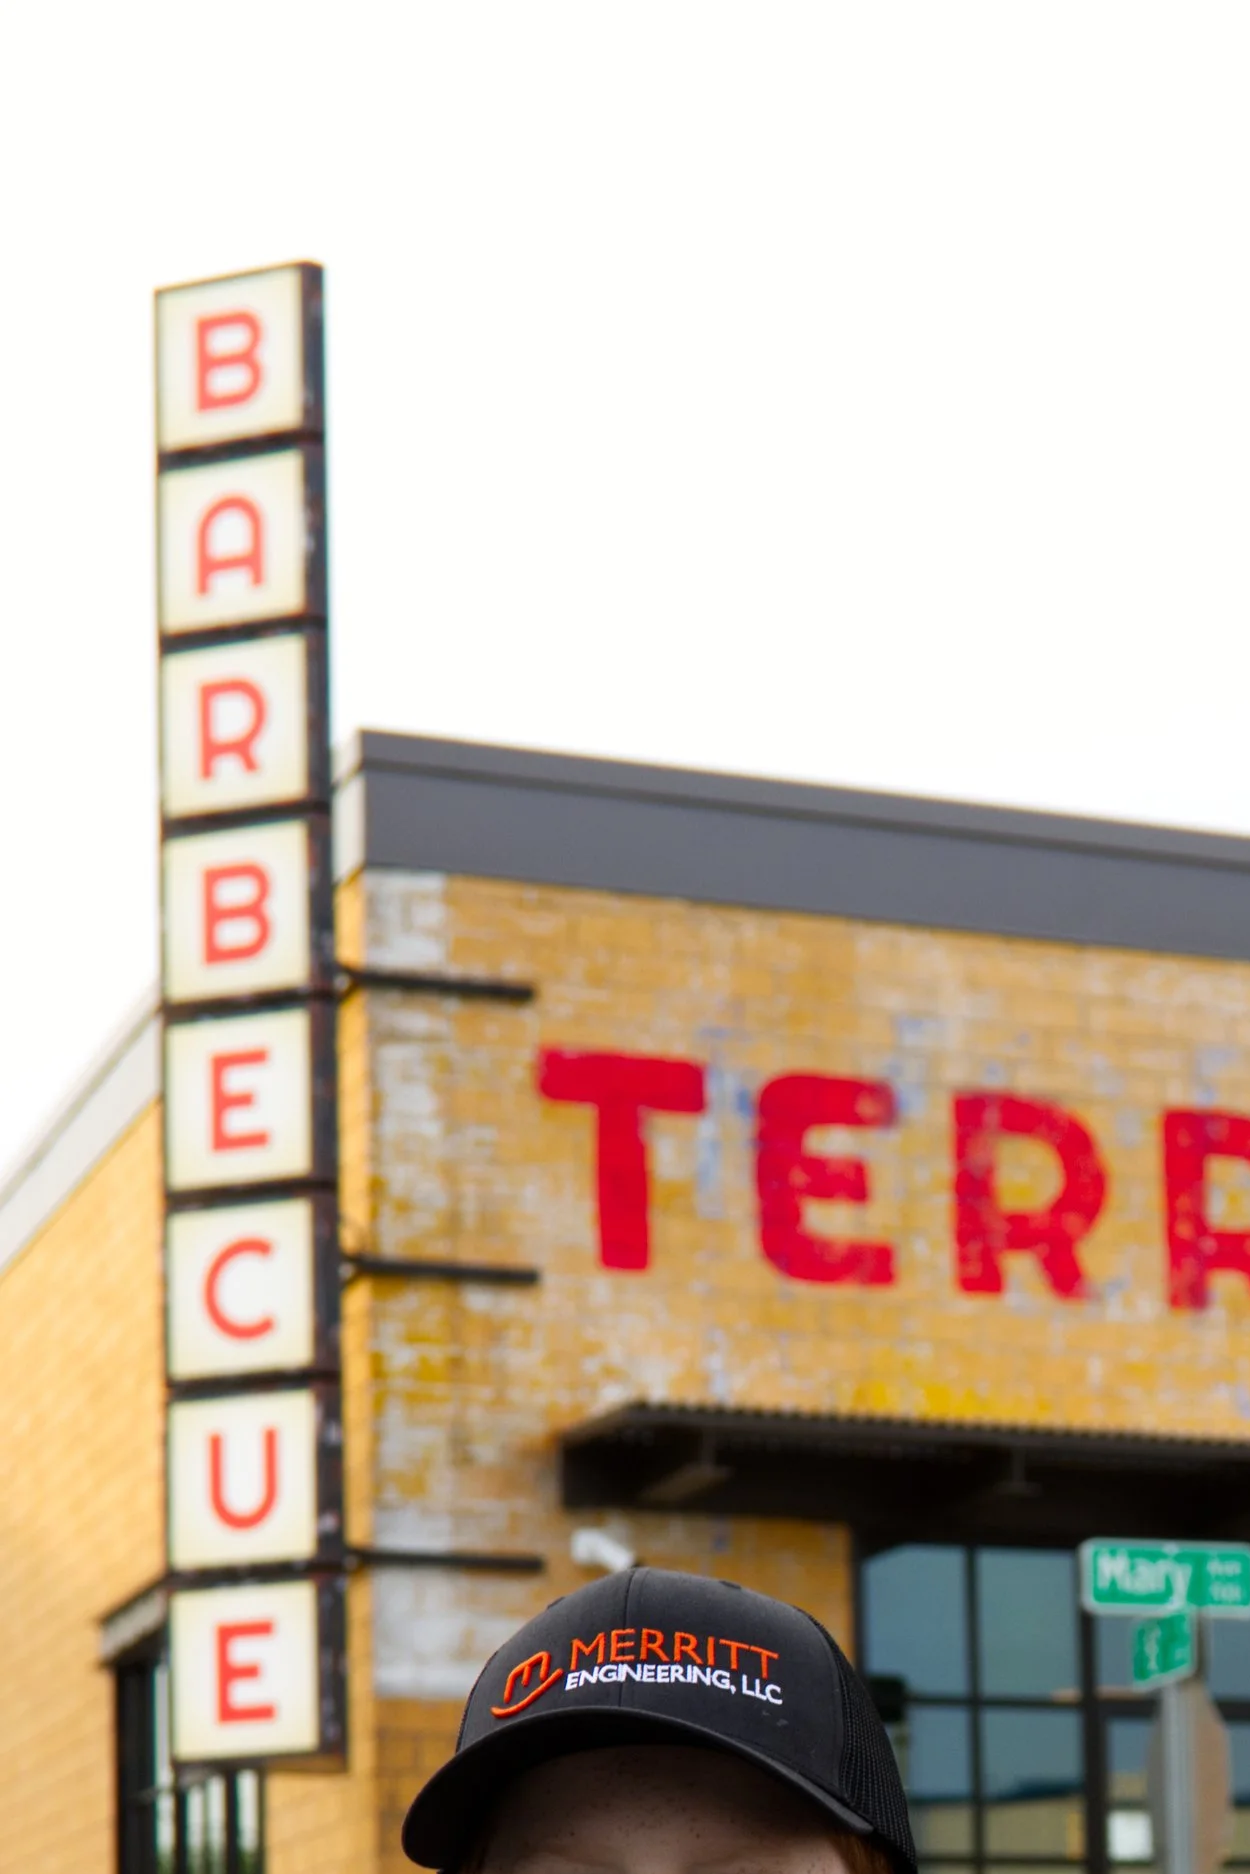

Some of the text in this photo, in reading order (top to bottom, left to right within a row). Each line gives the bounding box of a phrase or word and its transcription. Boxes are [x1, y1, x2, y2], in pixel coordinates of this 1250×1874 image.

[194, 311, 278, 1725] BARBECUE
[1097, 1550, 1192, 1611] Mary
[570, 1627, 780, 1680] MERRITT
[564, 1663, 783, 1705] ENGINEERING, LLC
